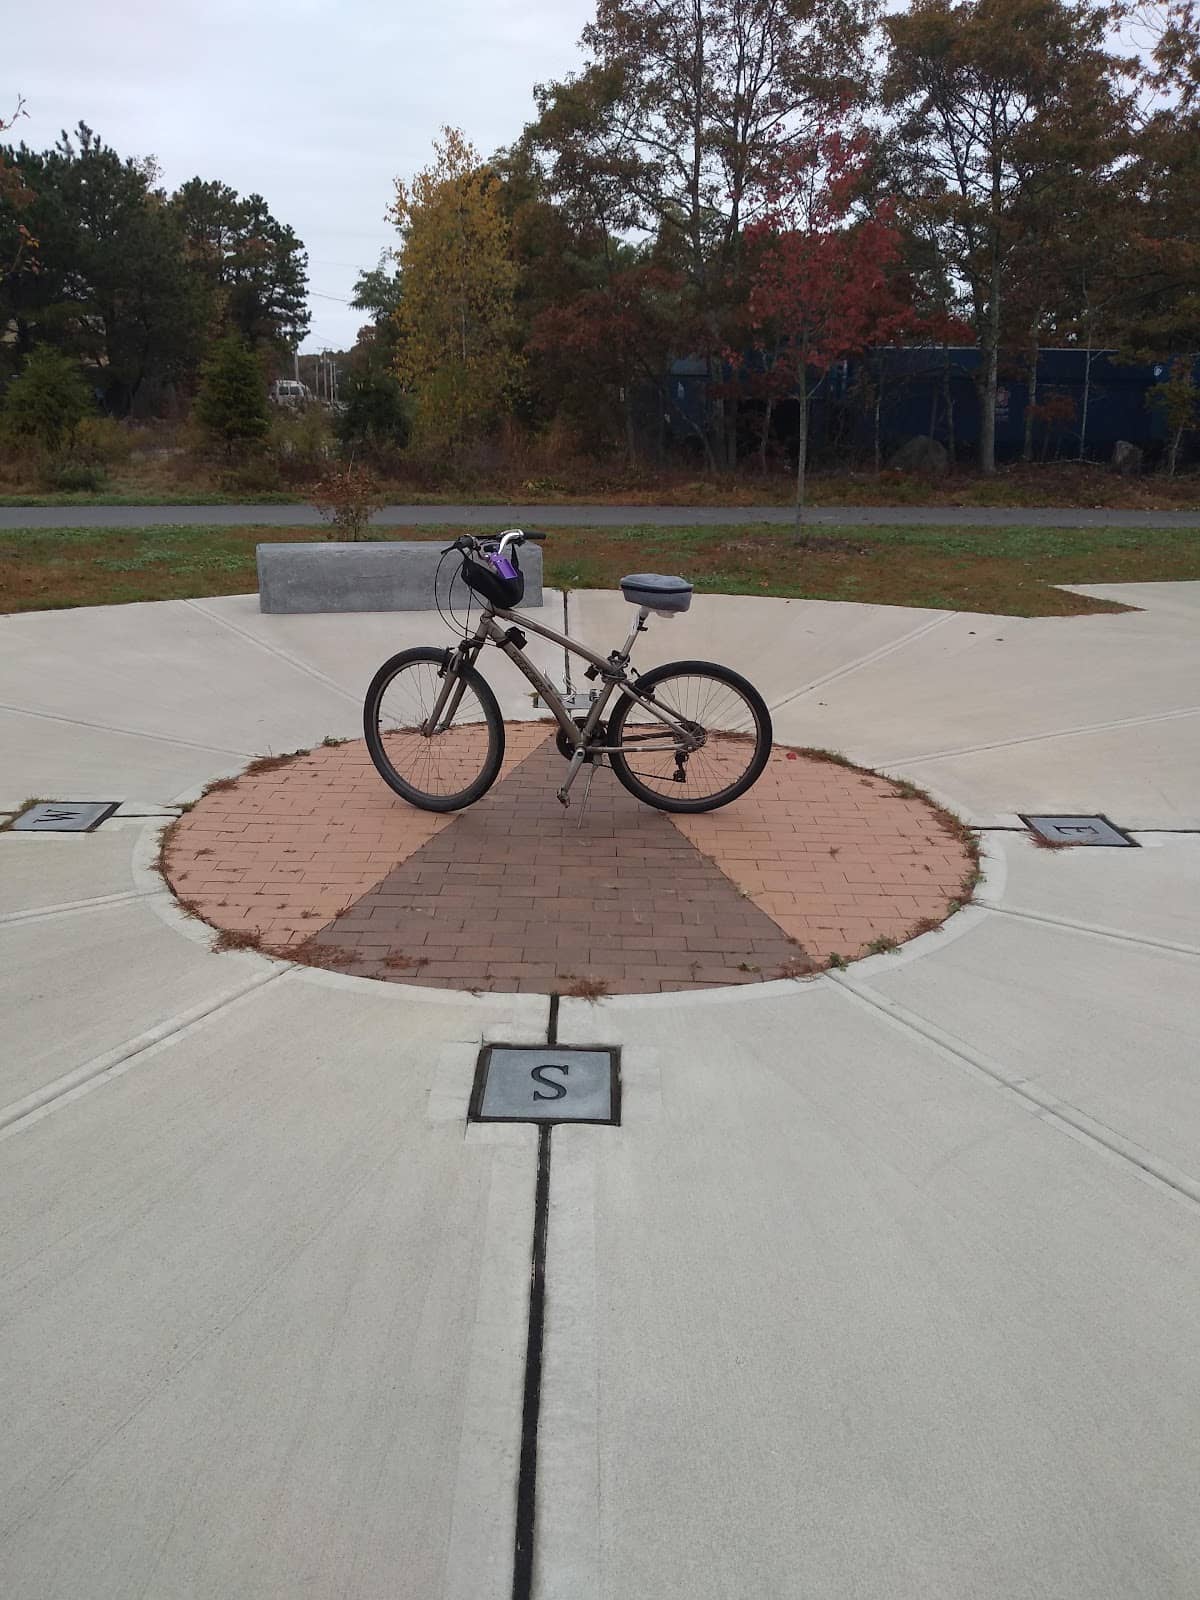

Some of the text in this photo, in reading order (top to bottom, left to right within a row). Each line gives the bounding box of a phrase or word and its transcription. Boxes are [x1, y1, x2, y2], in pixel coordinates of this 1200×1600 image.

[32, 809, 84, 823] W
[1052, 825, 1100, 835] E
[530, 1064, 570, 1101] S
